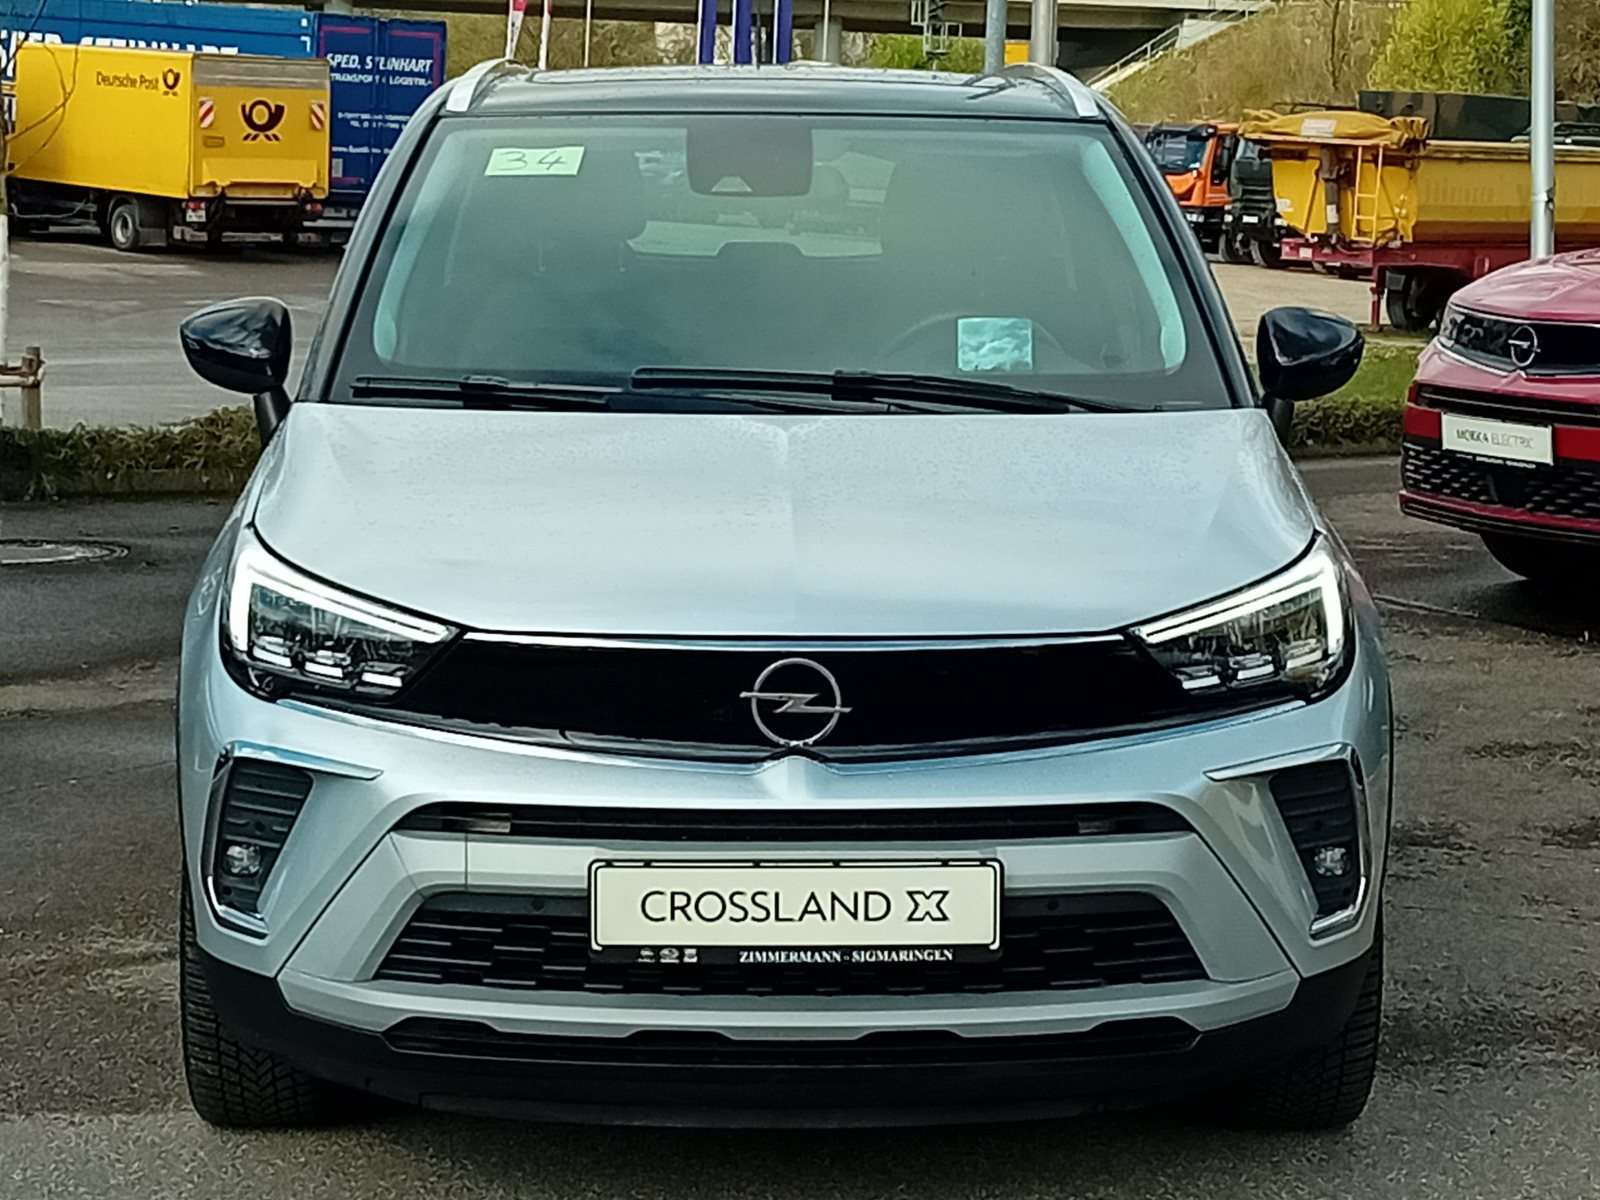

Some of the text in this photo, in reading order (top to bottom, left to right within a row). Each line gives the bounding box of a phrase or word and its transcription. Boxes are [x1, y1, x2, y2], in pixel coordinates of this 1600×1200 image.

[327, 53, 433, 73] SPED. STEINHART
[96, 71, 159, 91] Deutsche Post
[497, 150, 566, 171] 34
[641, 890, 950, 922] CROSSLAND X
[739, 949, 953, 963] ZIMMERMANN SIGMARINGEN
